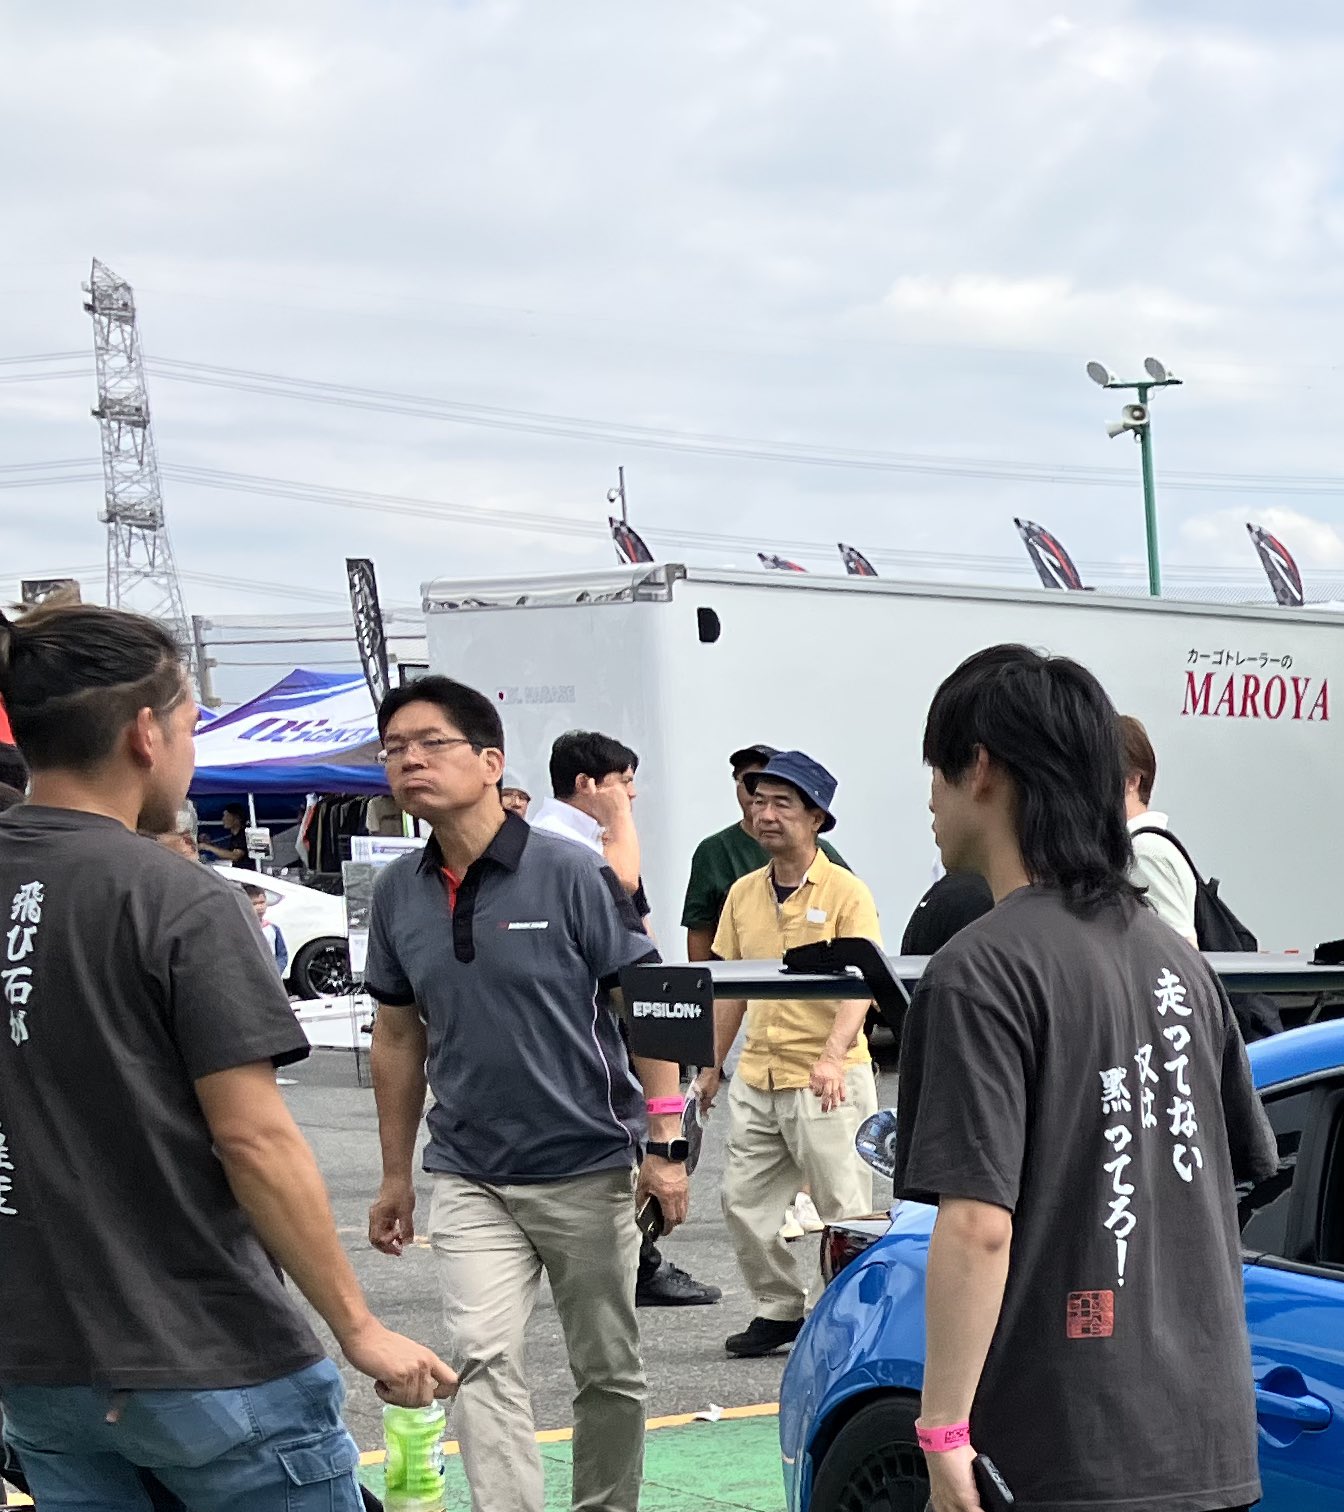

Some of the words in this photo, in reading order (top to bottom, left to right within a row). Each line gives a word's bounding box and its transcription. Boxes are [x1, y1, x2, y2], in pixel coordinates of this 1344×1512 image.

[1187, 648, 1294, 669] カーゴトレーラーの
[1181, 670, 1331, 722] MAROYA
[1153, 968, 1203, 1183] 走ってない
